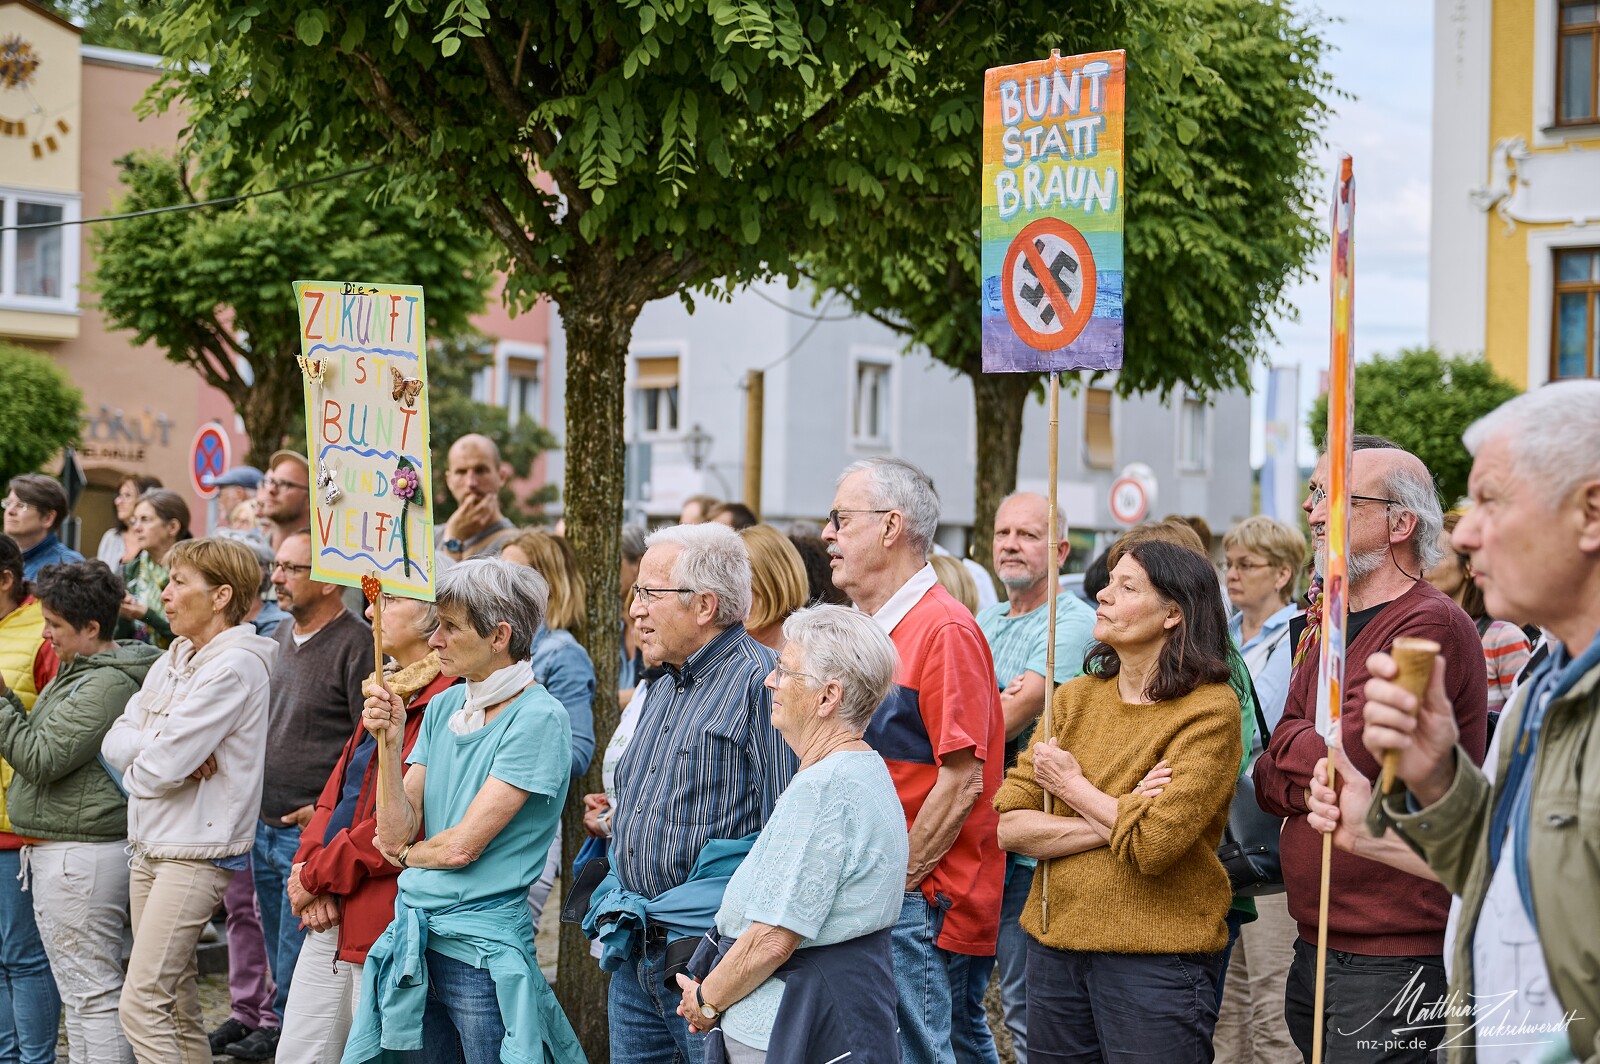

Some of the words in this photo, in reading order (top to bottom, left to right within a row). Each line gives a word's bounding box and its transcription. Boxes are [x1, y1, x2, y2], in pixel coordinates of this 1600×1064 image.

[1000, 60, 1110, 126] BUNT
[1002, 116, 1106, 168] STATT
[994, 163, 1118, 221] BRAUN
[344, 282, 365, 295] Die
[304, 291, 418, 344] ZUKUNFT
[340, 353, 386, 386] IST
[322, 400, 418, 450] BUNT
[344, 470, 389, 498] UND
[316, 507, 431, 560] VIELFALT
